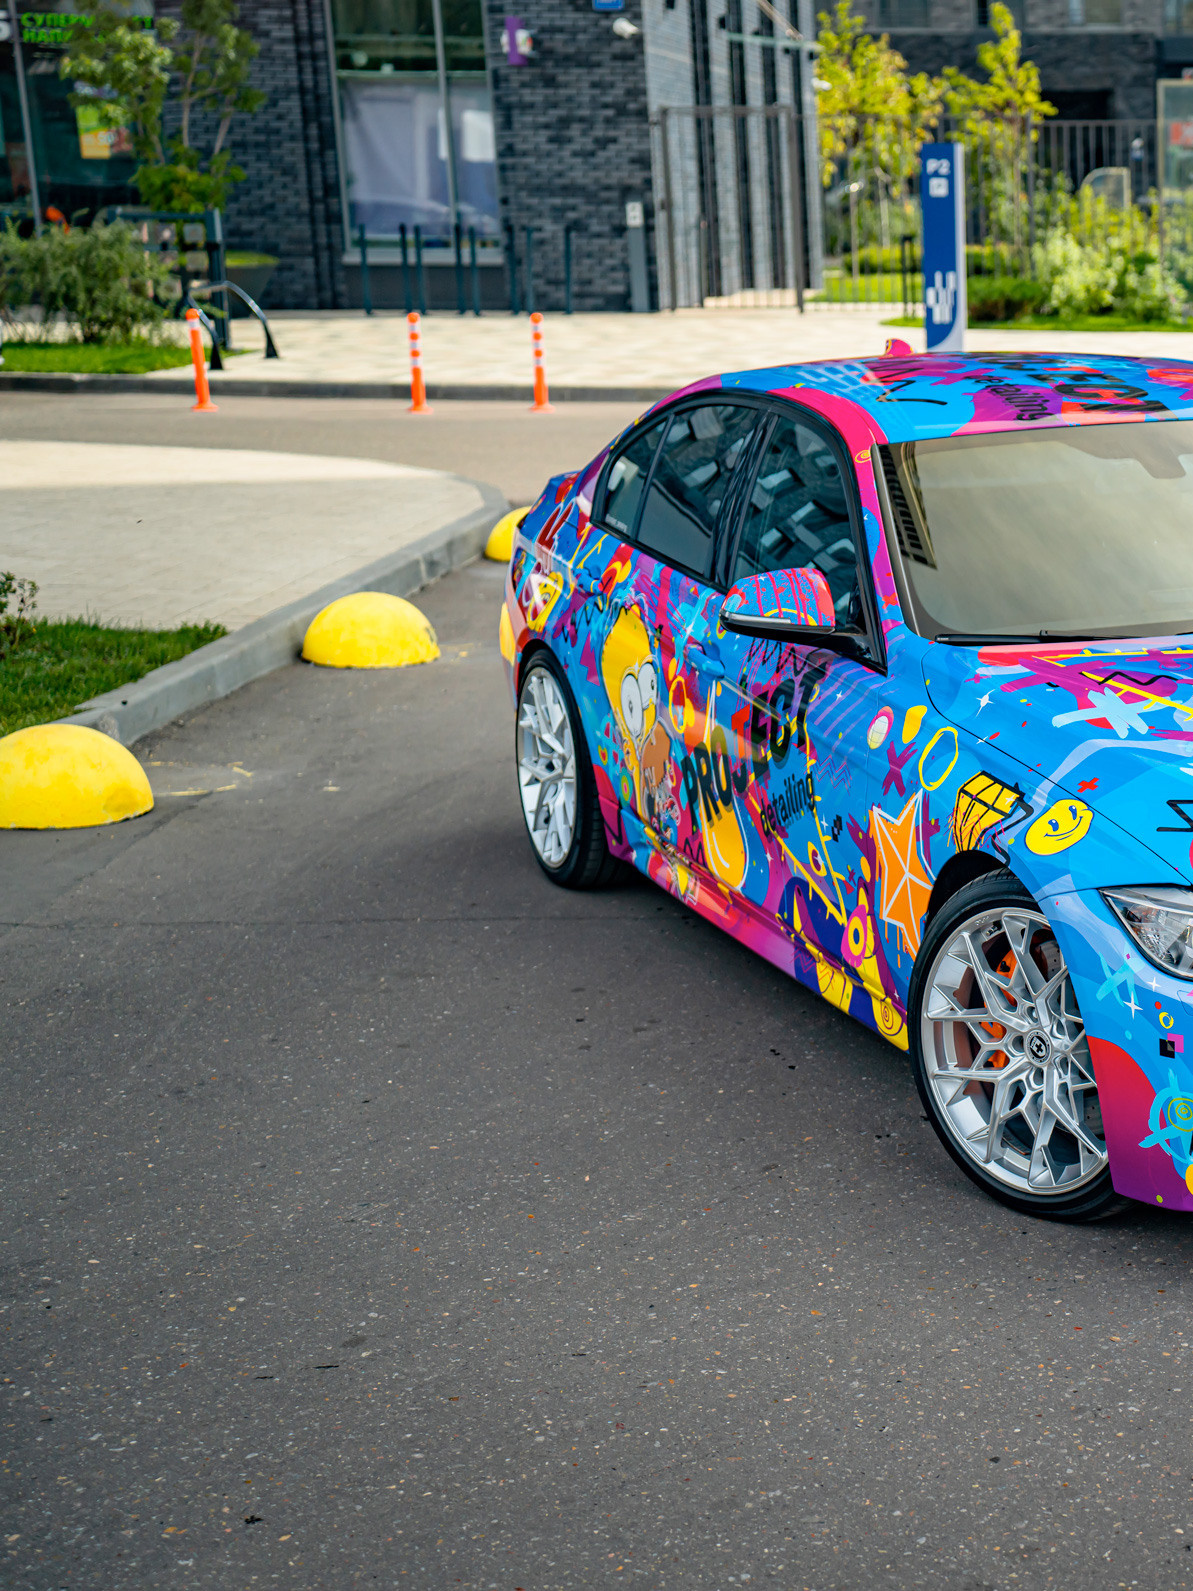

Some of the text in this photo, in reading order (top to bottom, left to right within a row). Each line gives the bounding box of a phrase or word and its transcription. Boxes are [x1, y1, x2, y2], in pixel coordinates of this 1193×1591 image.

[926, 158, 951, 175] P2
[681, 661, 828, 836] PROJECT
[760, 771, 816, 839] detailing
